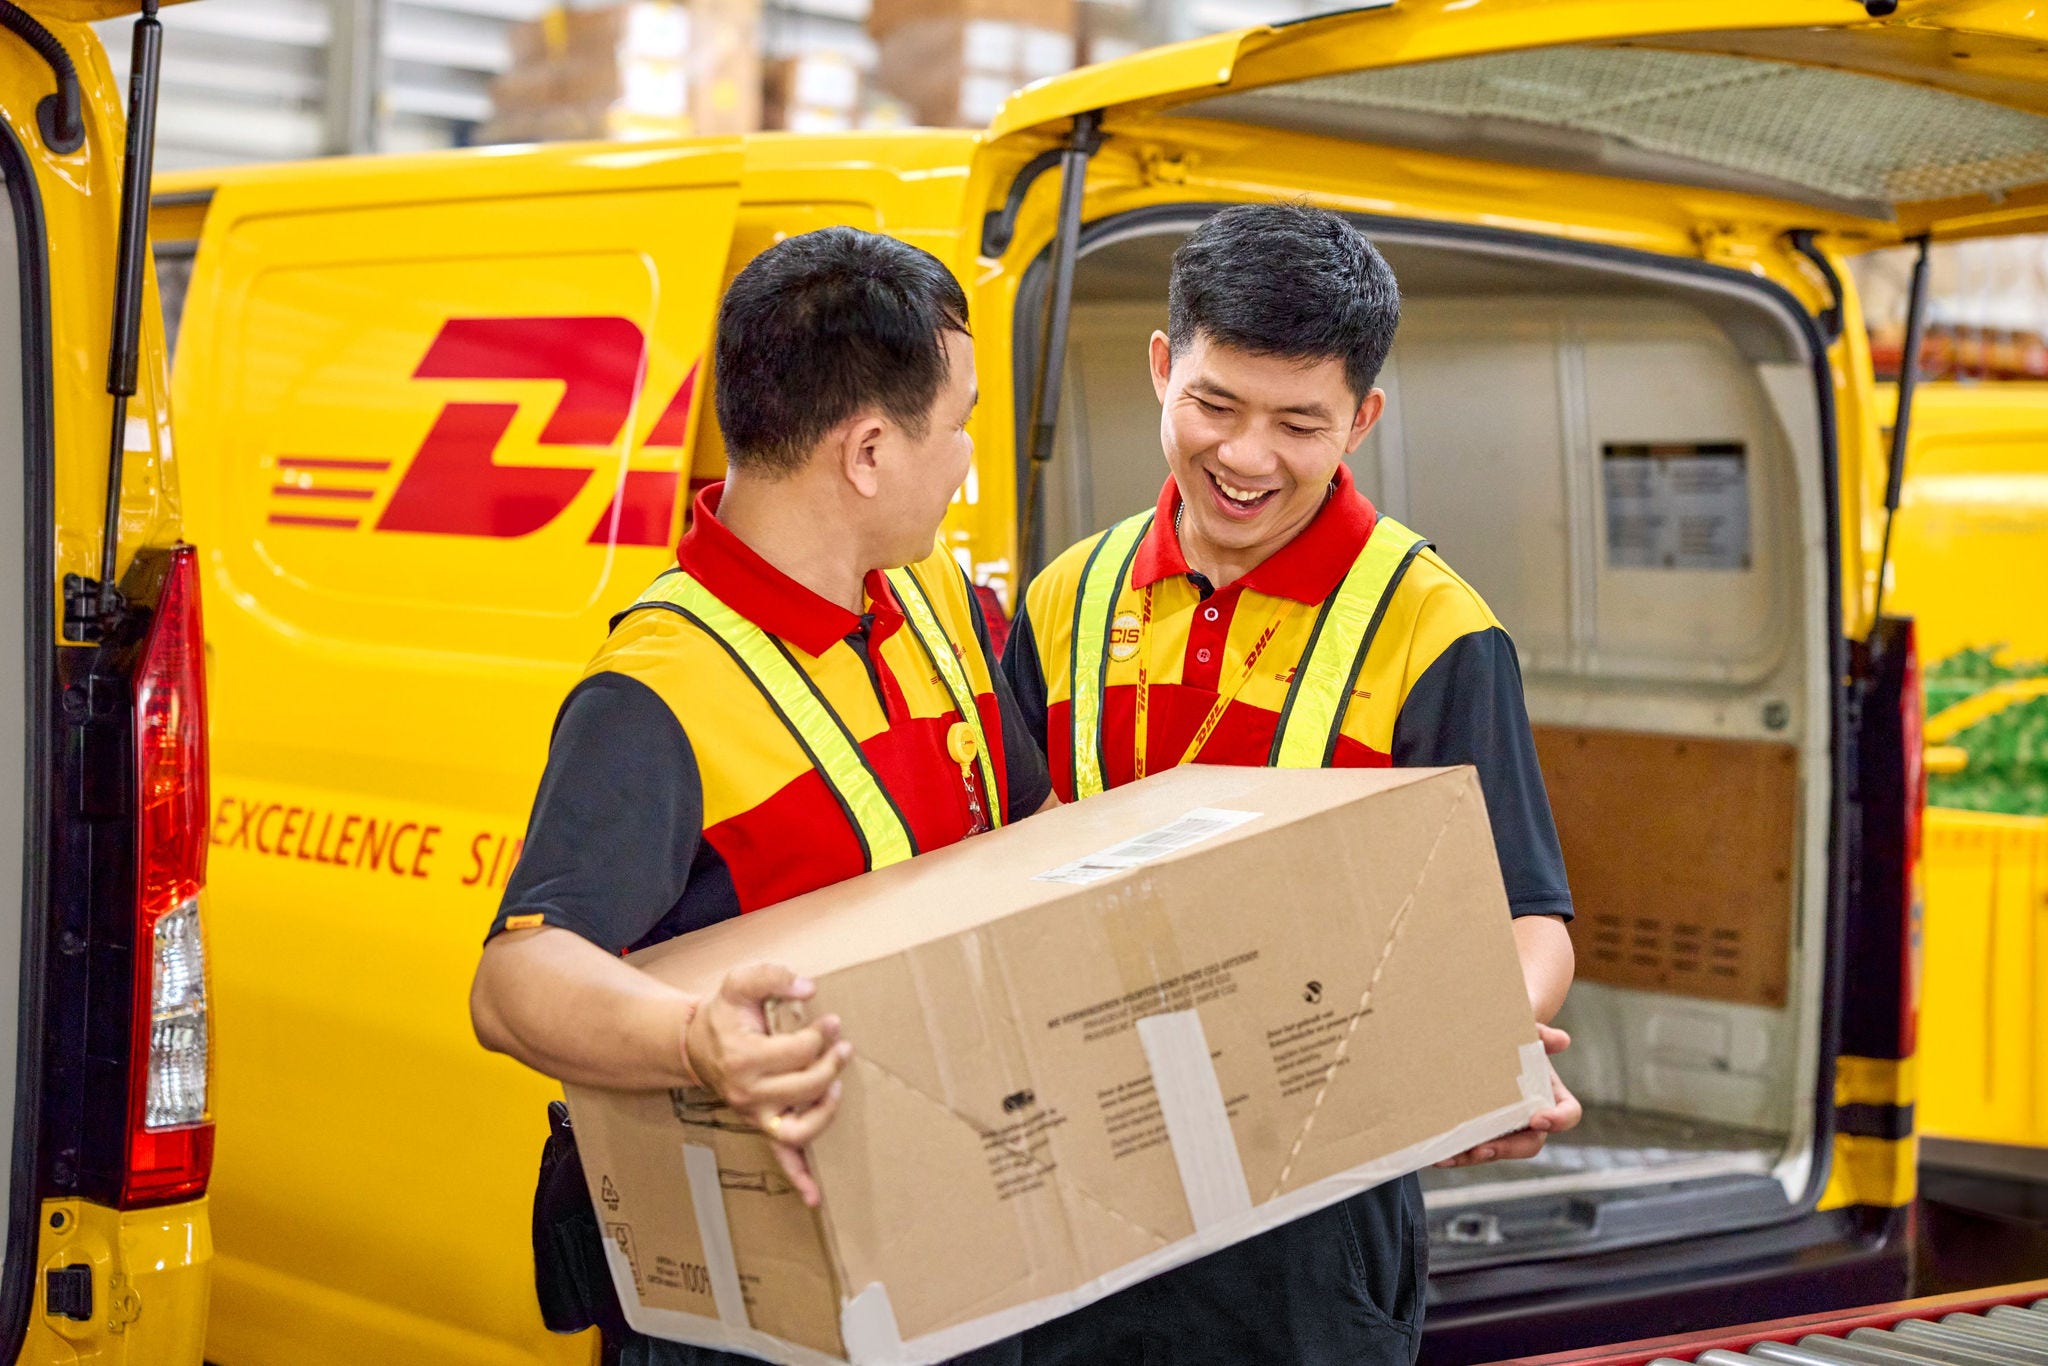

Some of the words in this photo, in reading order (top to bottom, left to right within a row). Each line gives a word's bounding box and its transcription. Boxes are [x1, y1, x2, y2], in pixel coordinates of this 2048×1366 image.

[1109, 628, 1140, 644] CIS
[1244, 627, 1276, 671] DHL
[1137, 668, 1147, 715] DHL
[1196, 704, 1224, 746] DHL
[211, 796, 442, 880] EXCELLENCE
